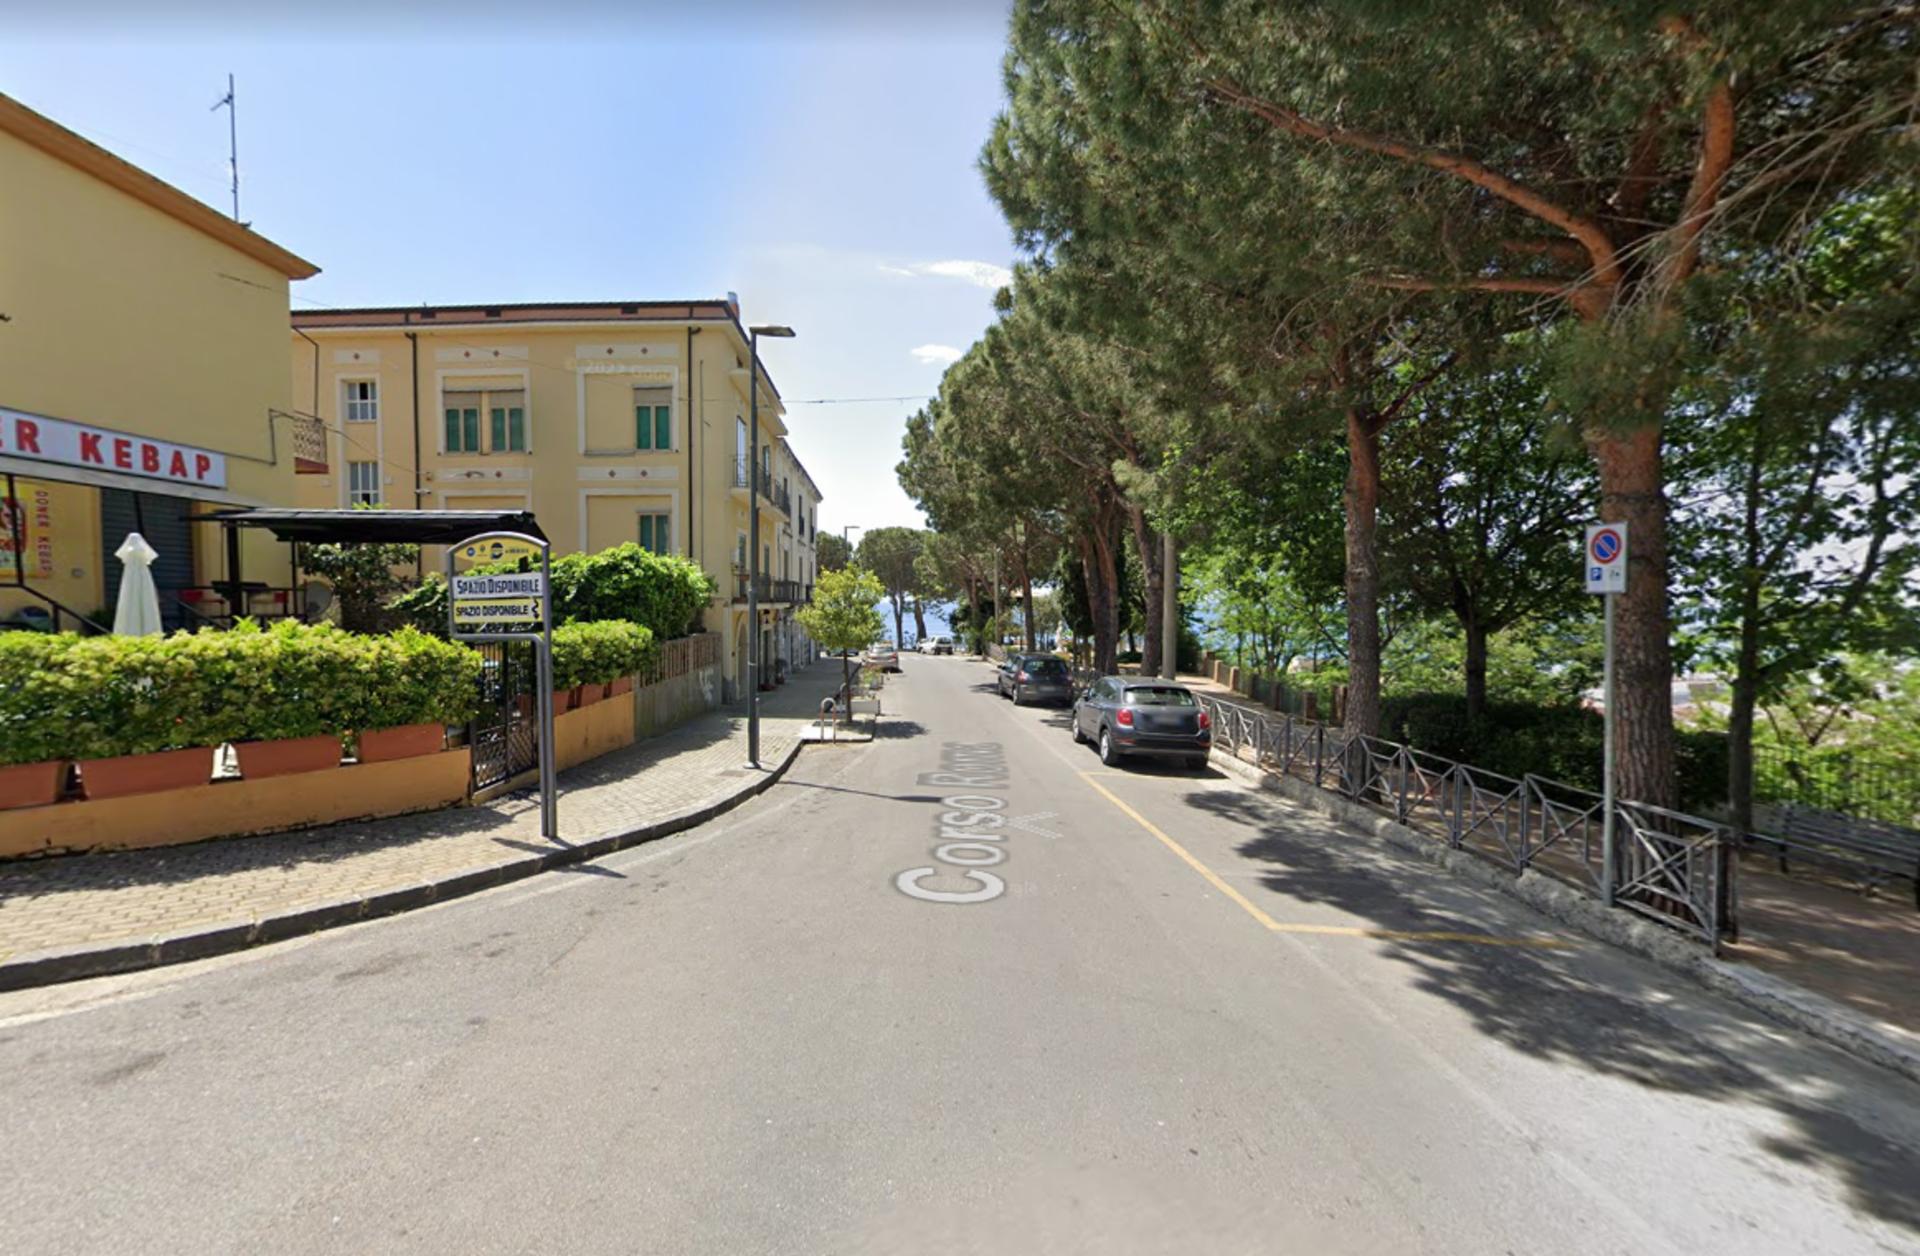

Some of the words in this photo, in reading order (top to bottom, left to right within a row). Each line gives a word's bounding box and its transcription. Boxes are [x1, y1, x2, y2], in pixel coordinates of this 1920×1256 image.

[0, 415, 41, 453] R
[79, 431, 212, 480] KEBAP
[457, 579, 486, 595] SPAZIO
[487, 578, 540, 594] DISPONIBILE
[455, 604, 481, 617] SPAZIO
[482, 603, 529, 617] DISPONIBILE
